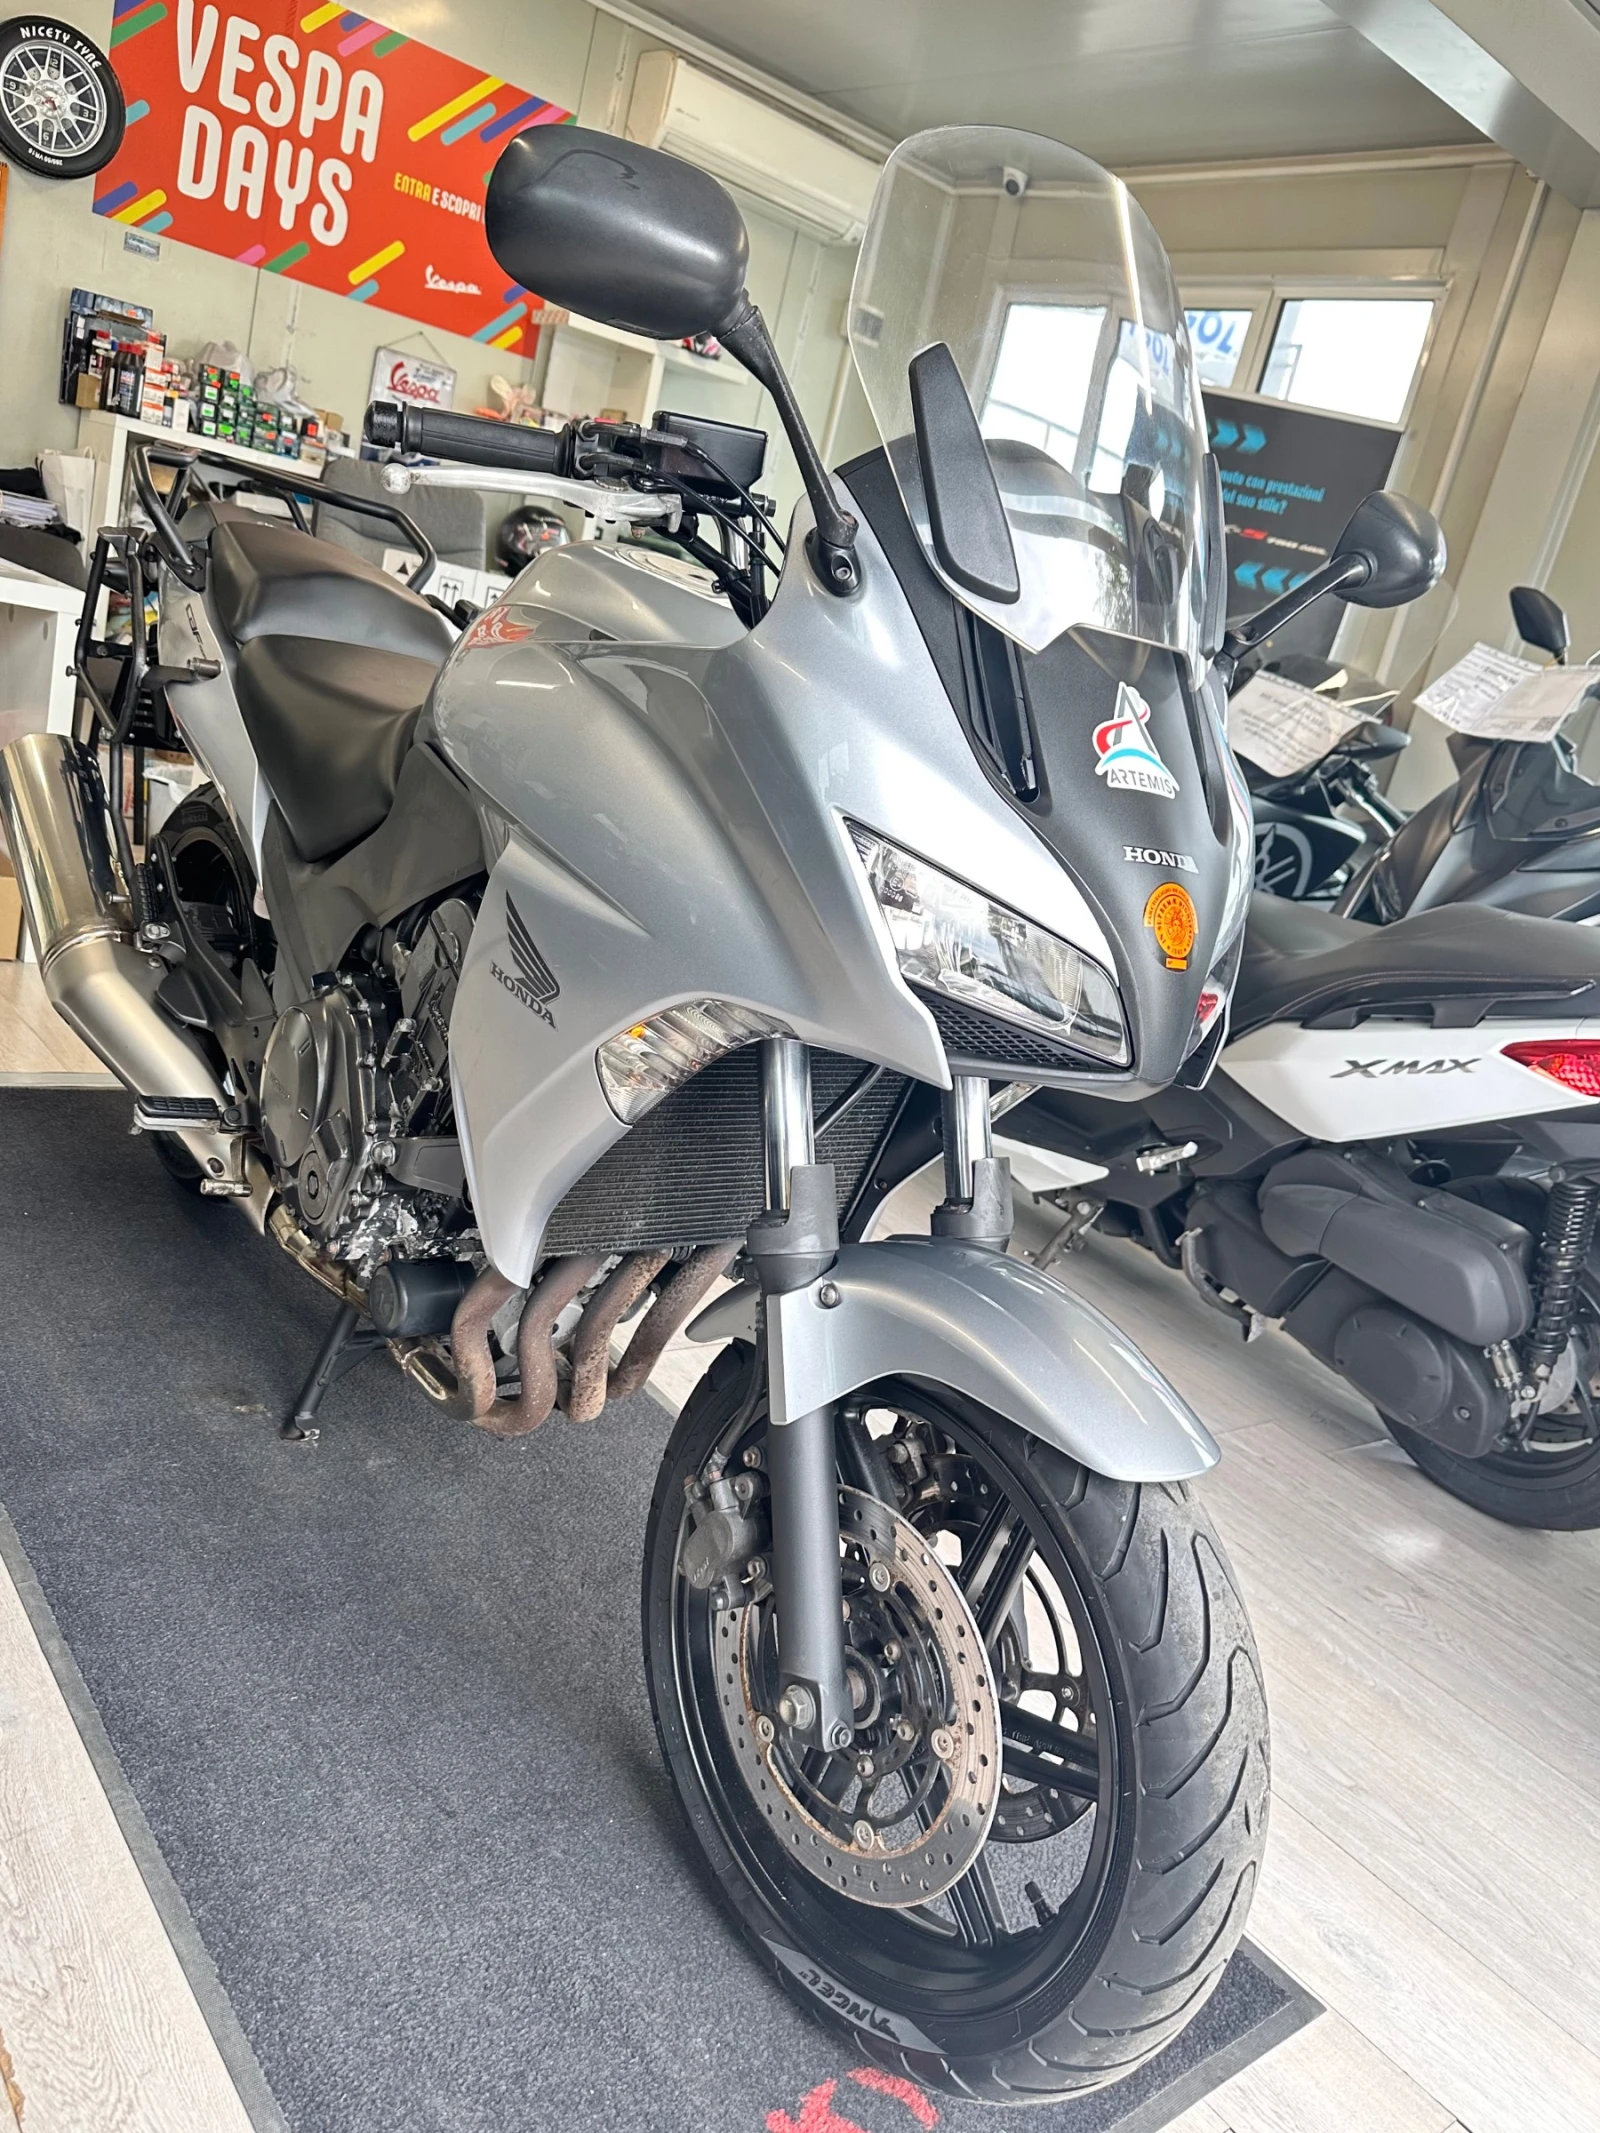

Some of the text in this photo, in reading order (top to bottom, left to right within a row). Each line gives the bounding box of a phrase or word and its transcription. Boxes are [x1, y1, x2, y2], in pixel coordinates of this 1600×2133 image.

[20, 26, 102, 69] NICETY TYRE
[176, 0, 384, 163] VESPA
[176, 105, 353, 247] DAYS
[394, 172, 482, 223] ENTRA E SCOPRI
[424, 264, 482, 296] Vespa
[387, 361, 440, 404] Vespa
[1265, 480, 1326, 503] prestazioni
[1110, 767, 1173, 796] ARTEMIS
[490, 960, 557, 1029] HONDA
[808, 1968, 901, 2043] ANGEL
